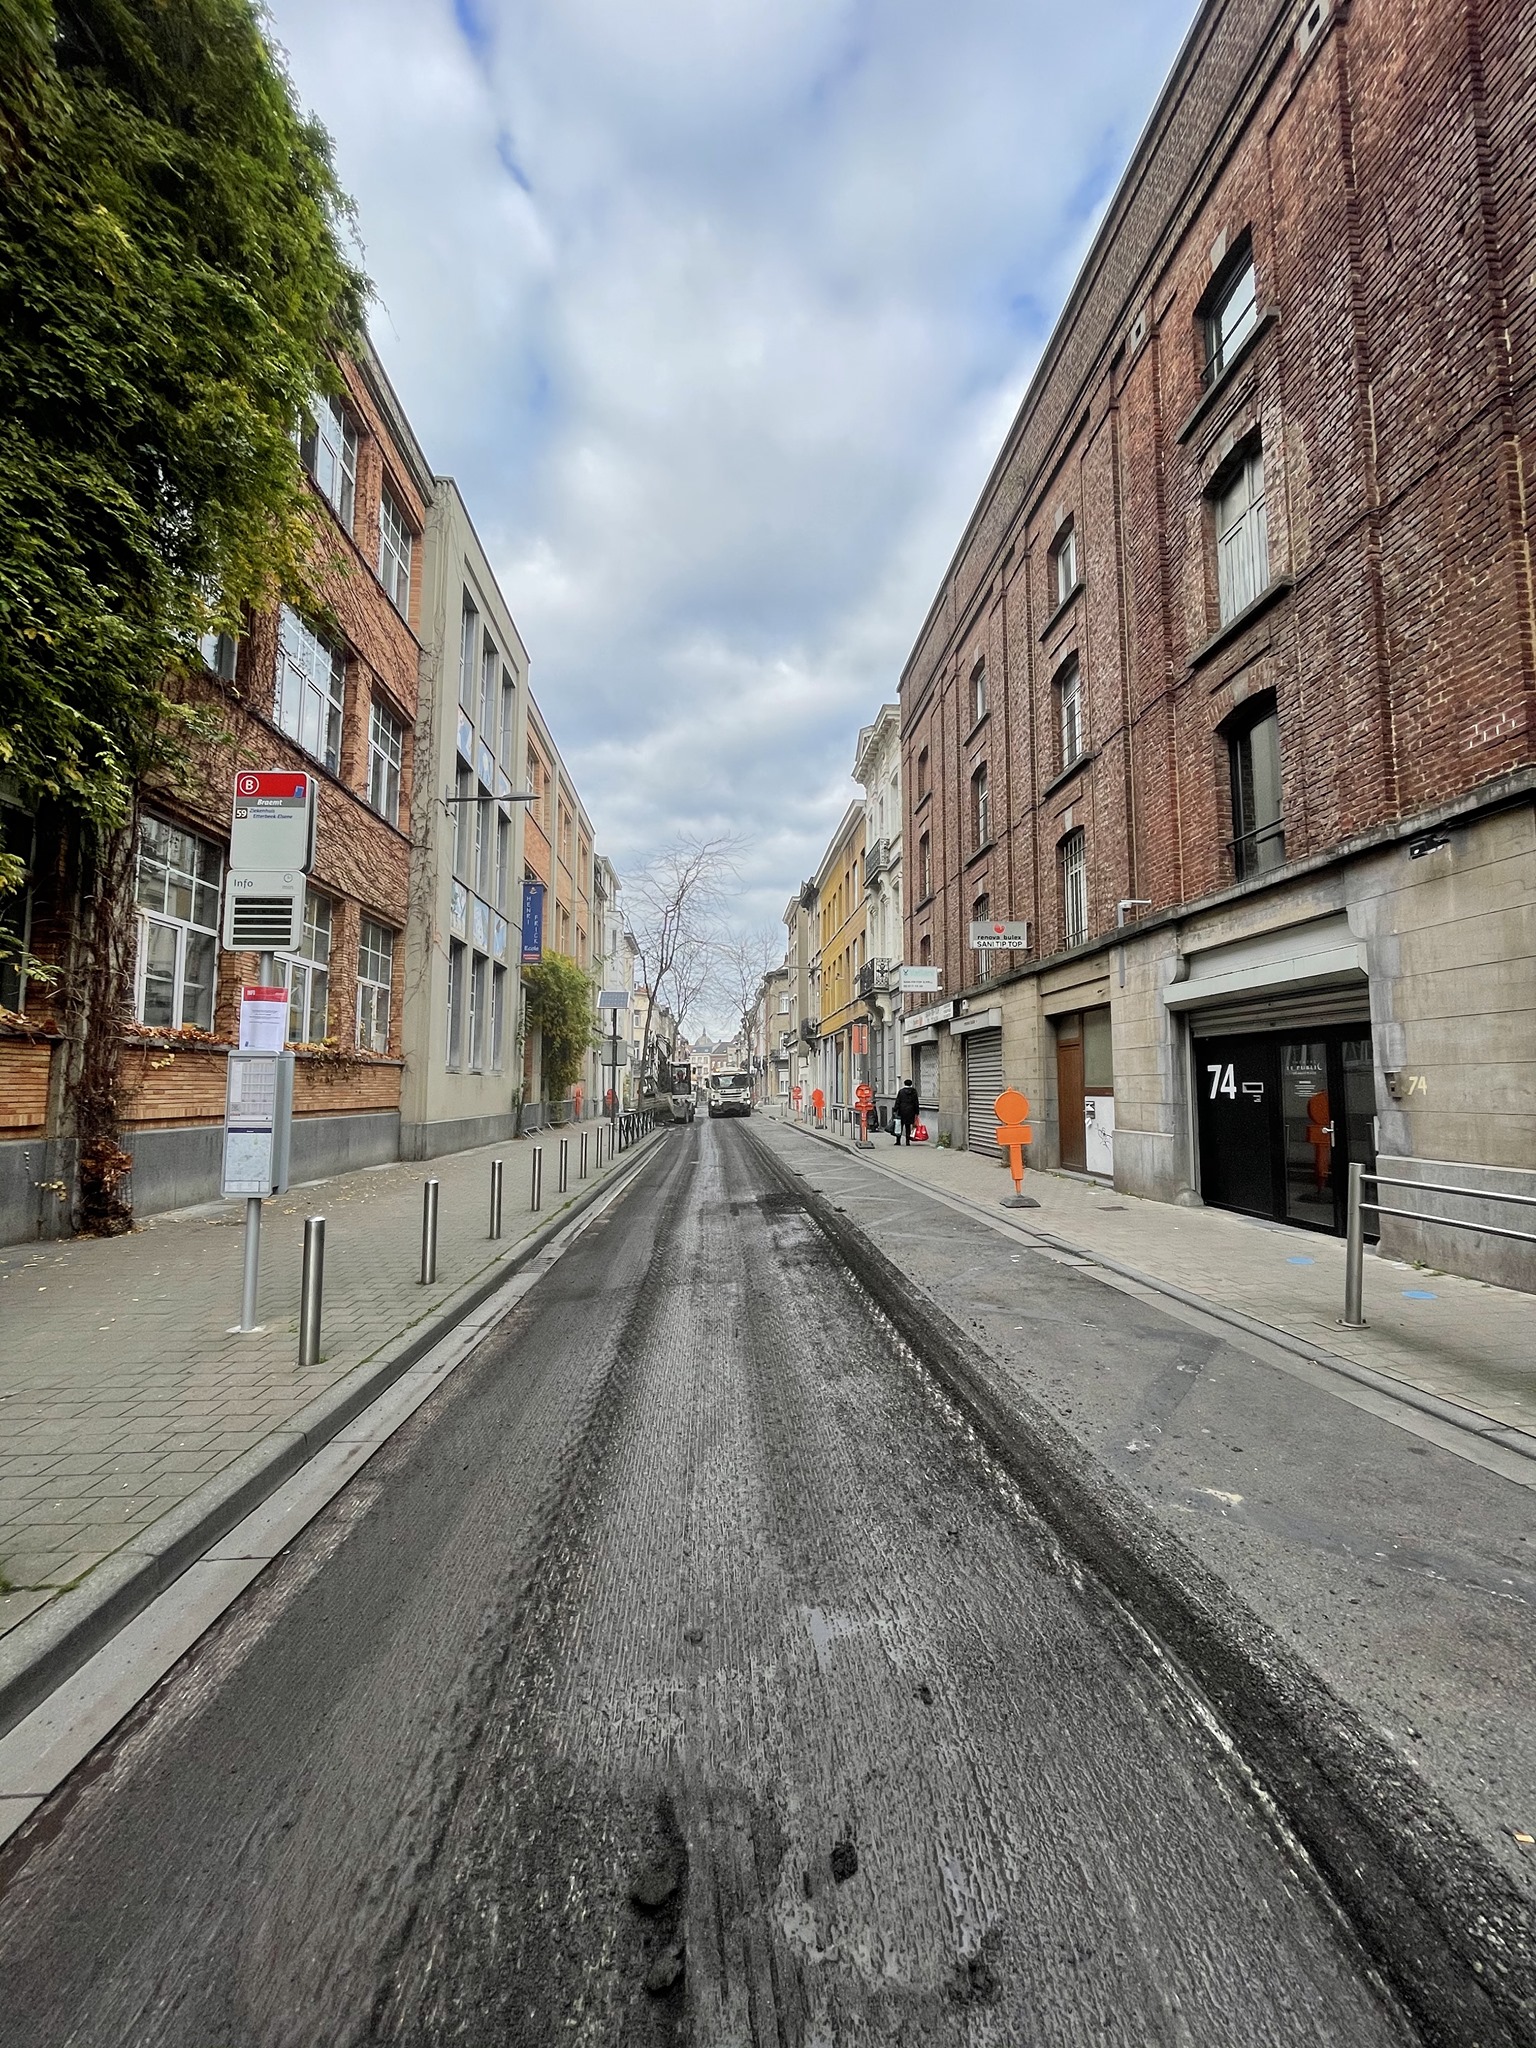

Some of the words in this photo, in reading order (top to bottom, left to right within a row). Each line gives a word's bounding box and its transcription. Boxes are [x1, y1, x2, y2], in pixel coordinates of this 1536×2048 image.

[245, 779, 254, 790] B
[257, 798, 283, 806] Braemt
[236, 809, 247, 818] 59
[234, 878, 253, 889] Info
[1008, 940, 1023, 948] TOP
[1207, 1063, 1237, 1100] 74
[1407, 1076, 1427, 1096] 74
